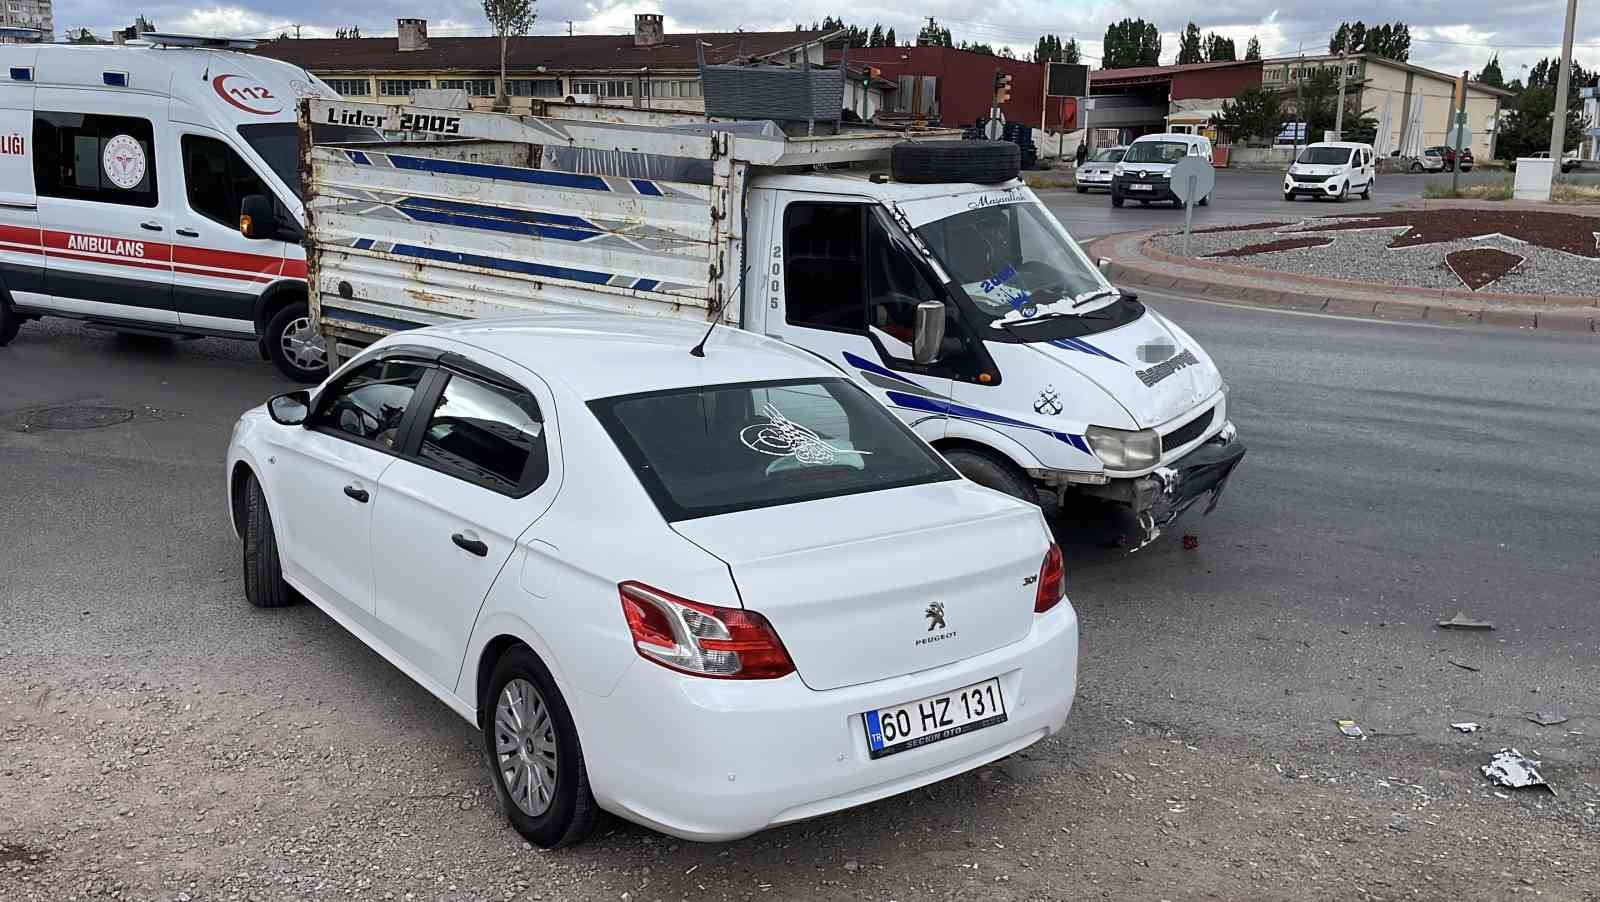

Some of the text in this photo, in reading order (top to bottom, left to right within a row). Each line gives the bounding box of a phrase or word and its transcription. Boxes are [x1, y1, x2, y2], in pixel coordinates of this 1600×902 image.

[230, 87, 275, 100] 112
[327, 107, 461, 134] Lider 2005
[67, 234, 145, 258] AMBULANS
[770, 246, 781, 309] 2005
[914, 631, 957, 646] PEUGEOT
[871, 733, 882, 743] TR
[881, 709, 911, 742] 60
[918, 697, 954, 732] HZ
[960, 685, 997, 719] 131
[943, 727, 962, 739] OTO
